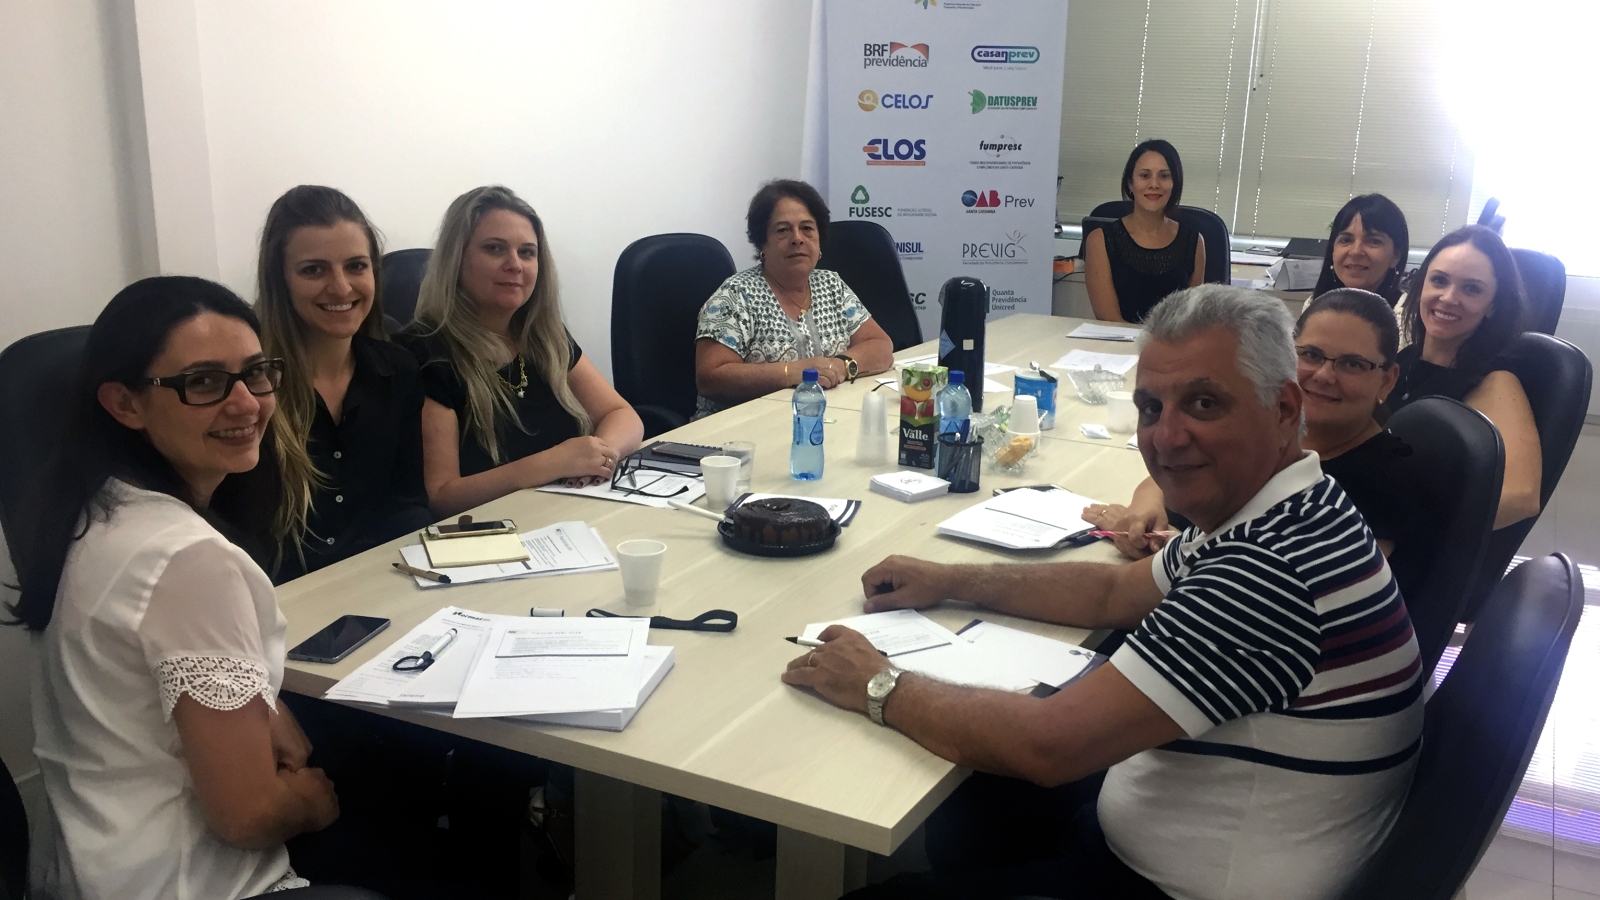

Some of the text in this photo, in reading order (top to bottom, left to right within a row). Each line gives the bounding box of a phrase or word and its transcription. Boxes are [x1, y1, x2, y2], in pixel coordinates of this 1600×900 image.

[864, 43, 888, 56] BRF
[977, 50, 1035, 61] casanprev
[864, 55, 927, 69] previdência
[881, 94, 934, 109] CELOS
[988, 96, 1038, 106] DATUSPREV
[862, 138, 926, 160] ELOS
[980, 140, 1022, 152] fumpresc
[962, 190, 1034, 208] OAB Prev
[849, 206, 892, 218] FUSESC
[894, 242, 924, 253] NISUL
[962, 243, 1016, 258] PREVIG
[902, 428, 928, 440] Valle
